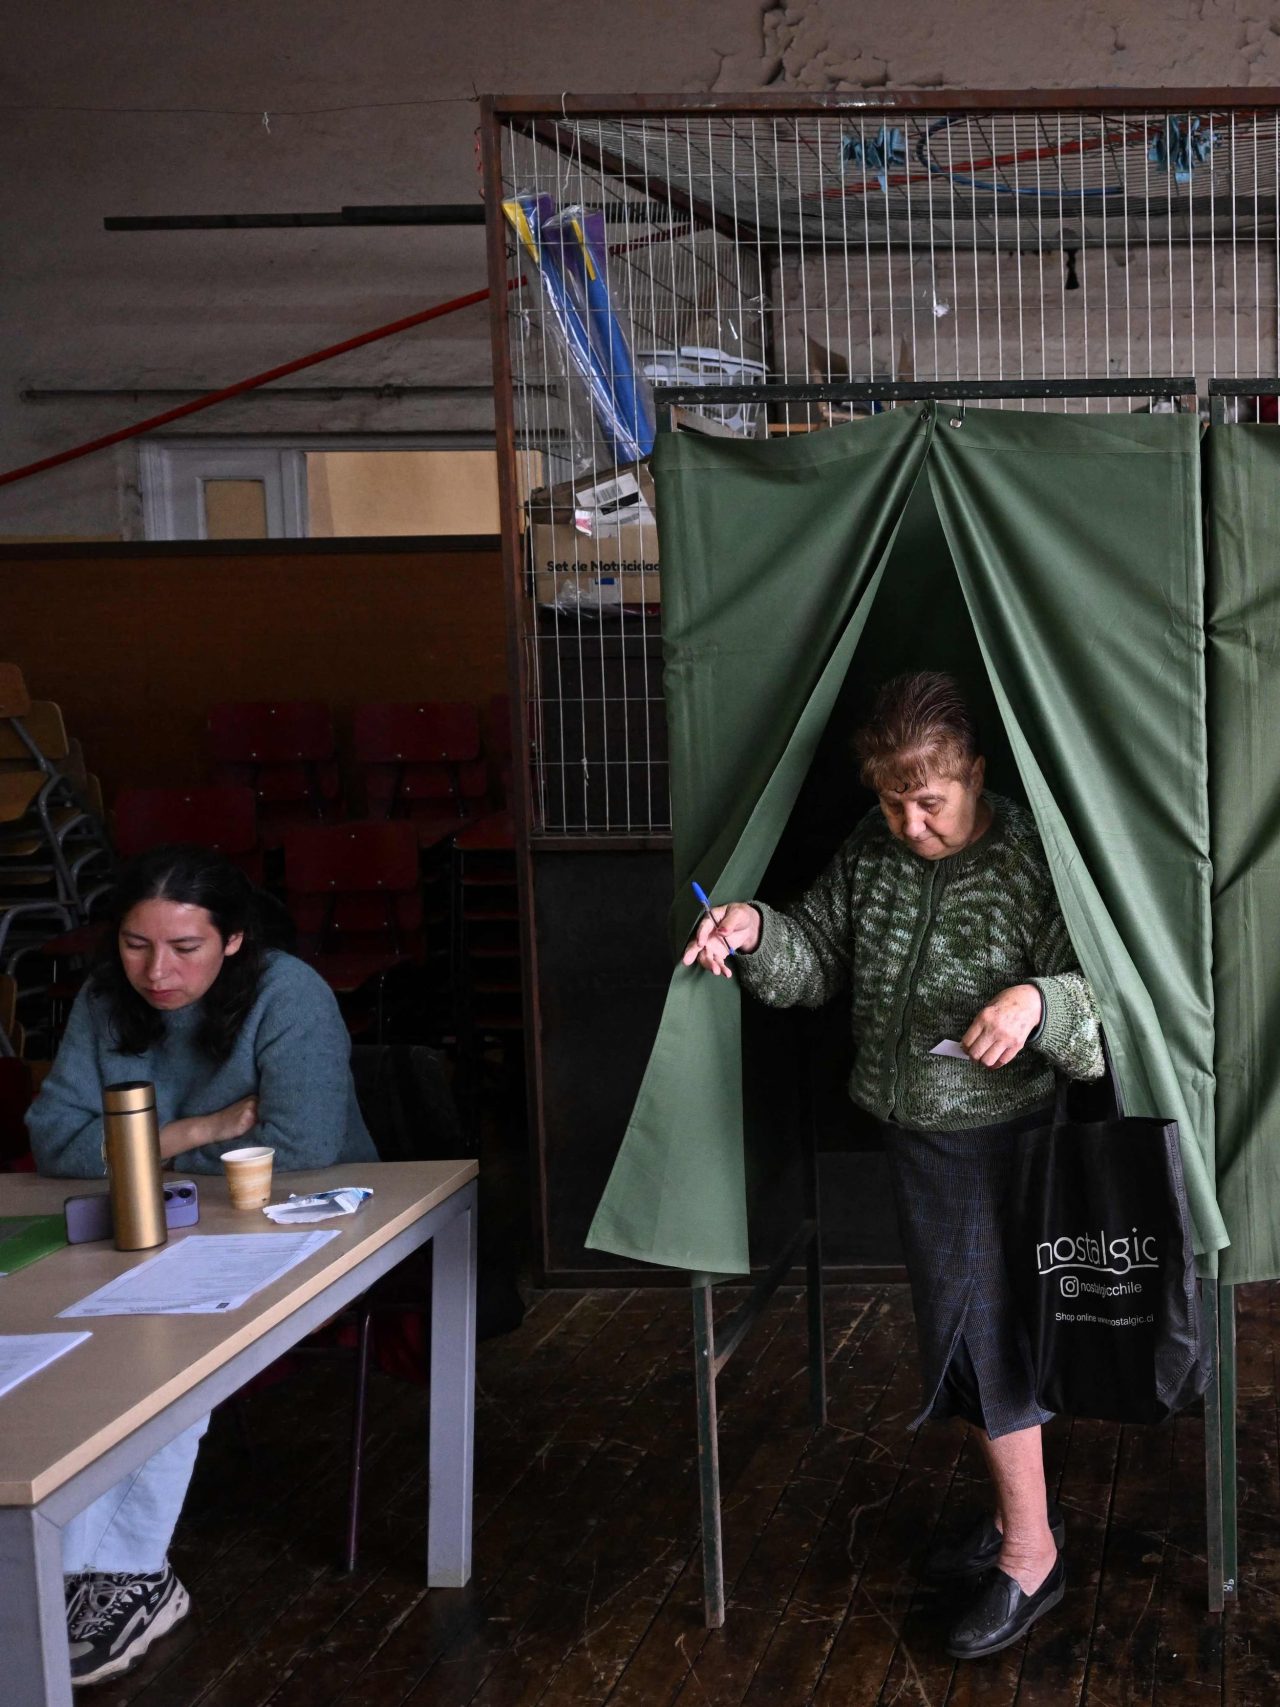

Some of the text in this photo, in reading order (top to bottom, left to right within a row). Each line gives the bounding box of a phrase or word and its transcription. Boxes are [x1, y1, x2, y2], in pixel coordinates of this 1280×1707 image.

[547, 560, 569, 572] Set
[572, 560, 588, 572] de
[1036, 1227, 1159, 1275] nostalgic
[1055, 1312, 1075, 1323] Shop
[1076, 1312, 1097, 1323] online
